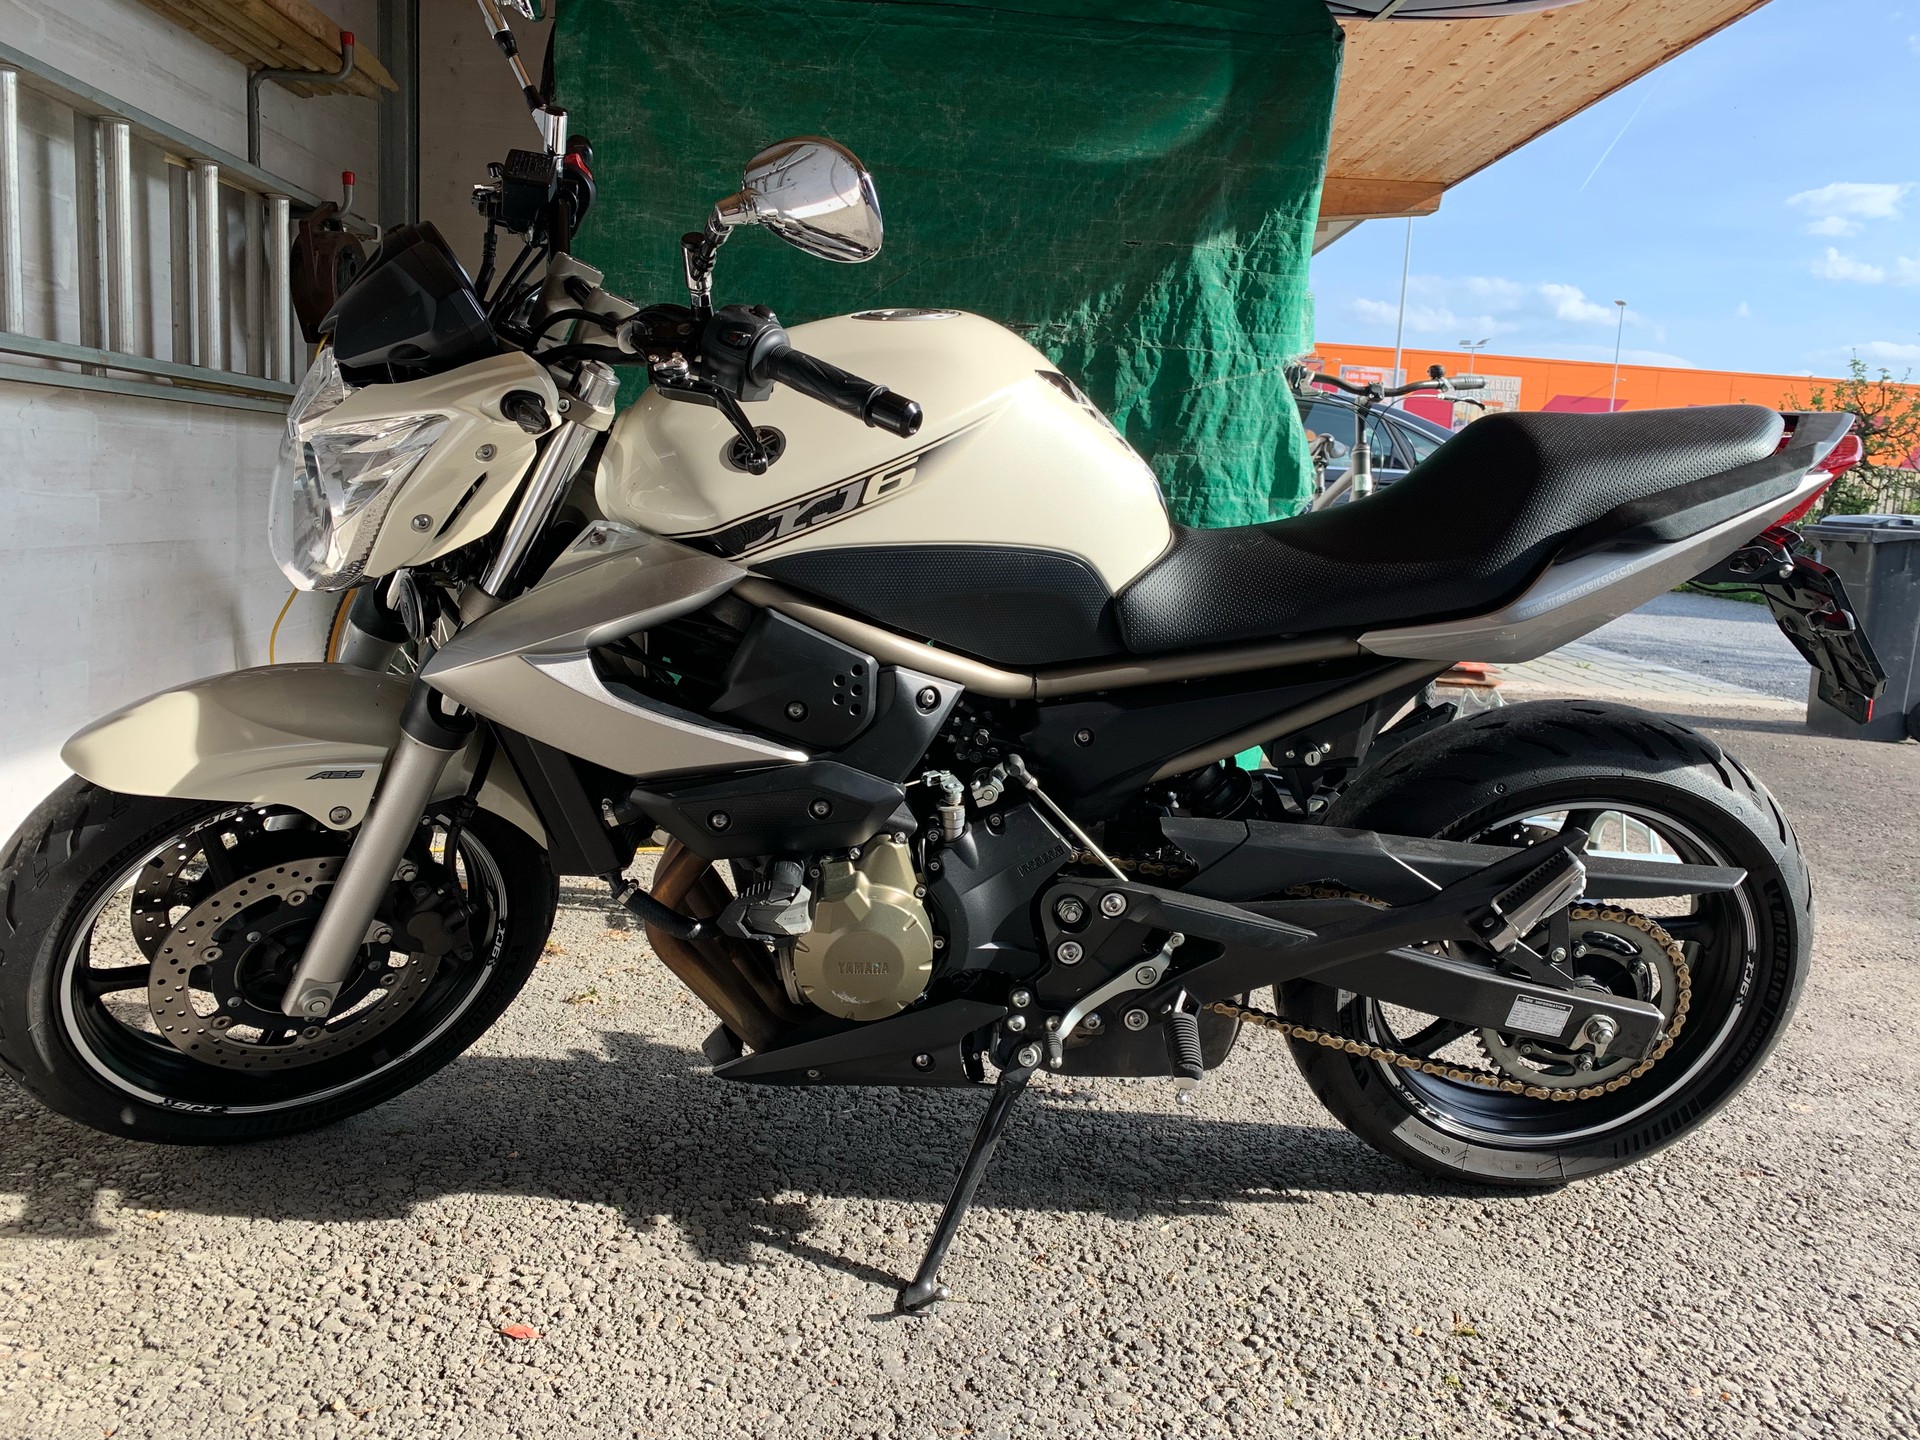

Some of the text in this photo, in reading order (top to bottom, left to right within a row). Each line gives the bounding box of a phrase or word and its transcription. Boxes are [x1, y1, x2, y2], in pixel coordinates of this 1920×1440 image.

[305, 769, 366, 780] ABS
[1767, 910, 1789, 1004] MICHELIN
[837, 961, 889, 975] YAMAHA
